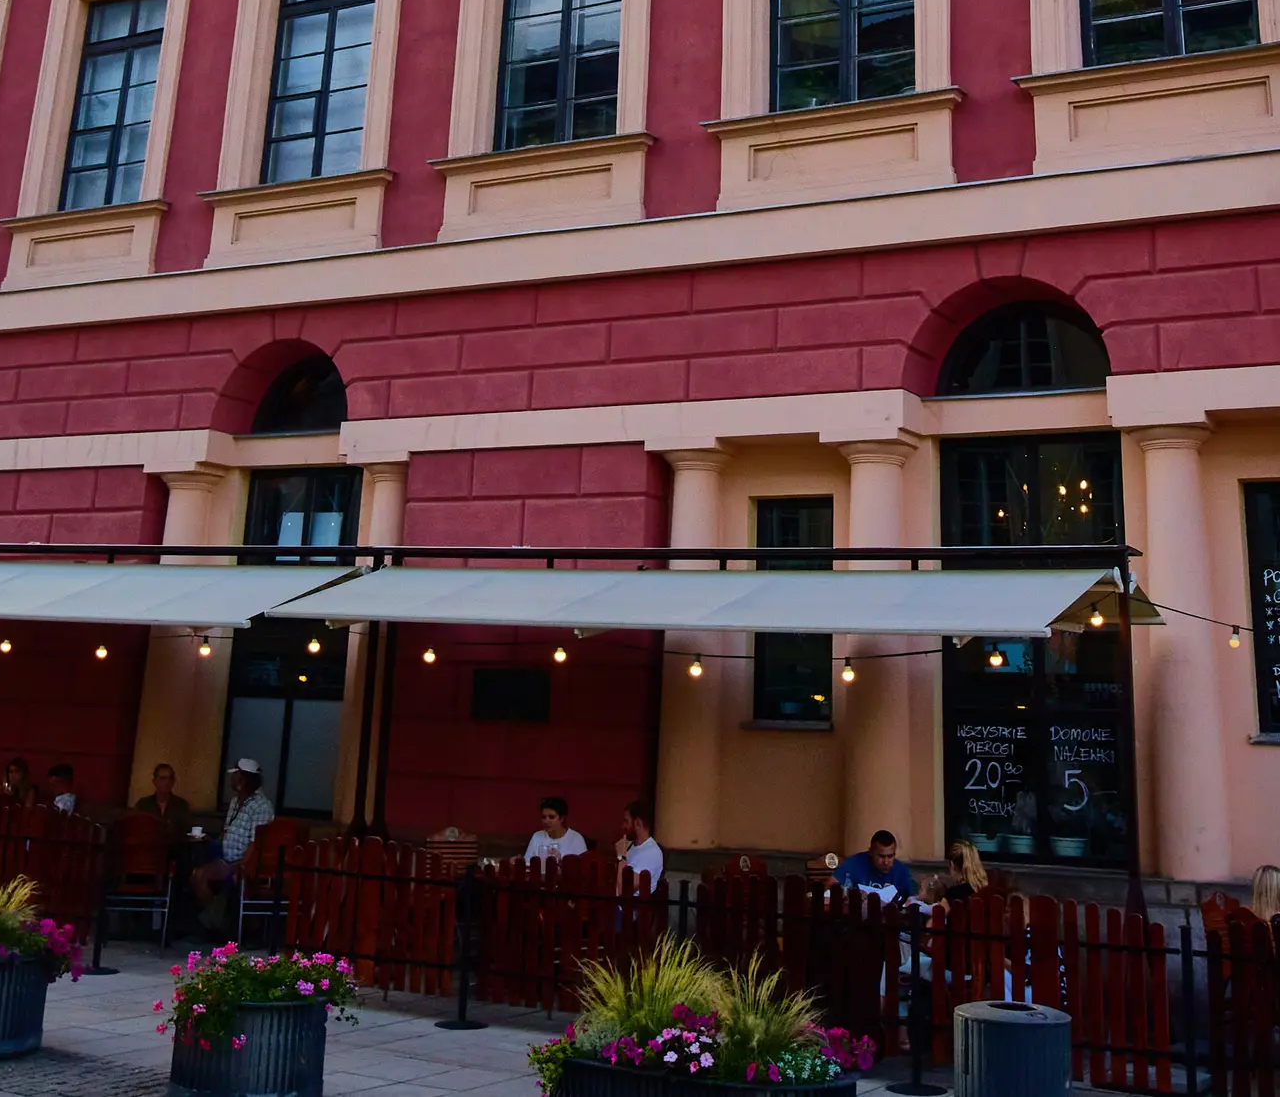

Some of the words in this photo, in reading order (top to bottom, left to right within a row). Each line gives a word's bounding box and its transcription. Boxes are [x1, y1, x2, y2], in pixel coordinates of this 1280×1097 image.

[957, 724, 1027, 739] WSZYSTKIE
[1049, 725, 1115, 741] DOMOWE
[965, 740, 1014, 755] PIEROGI
[1054, 745, 1115, 763] NALEWKI
